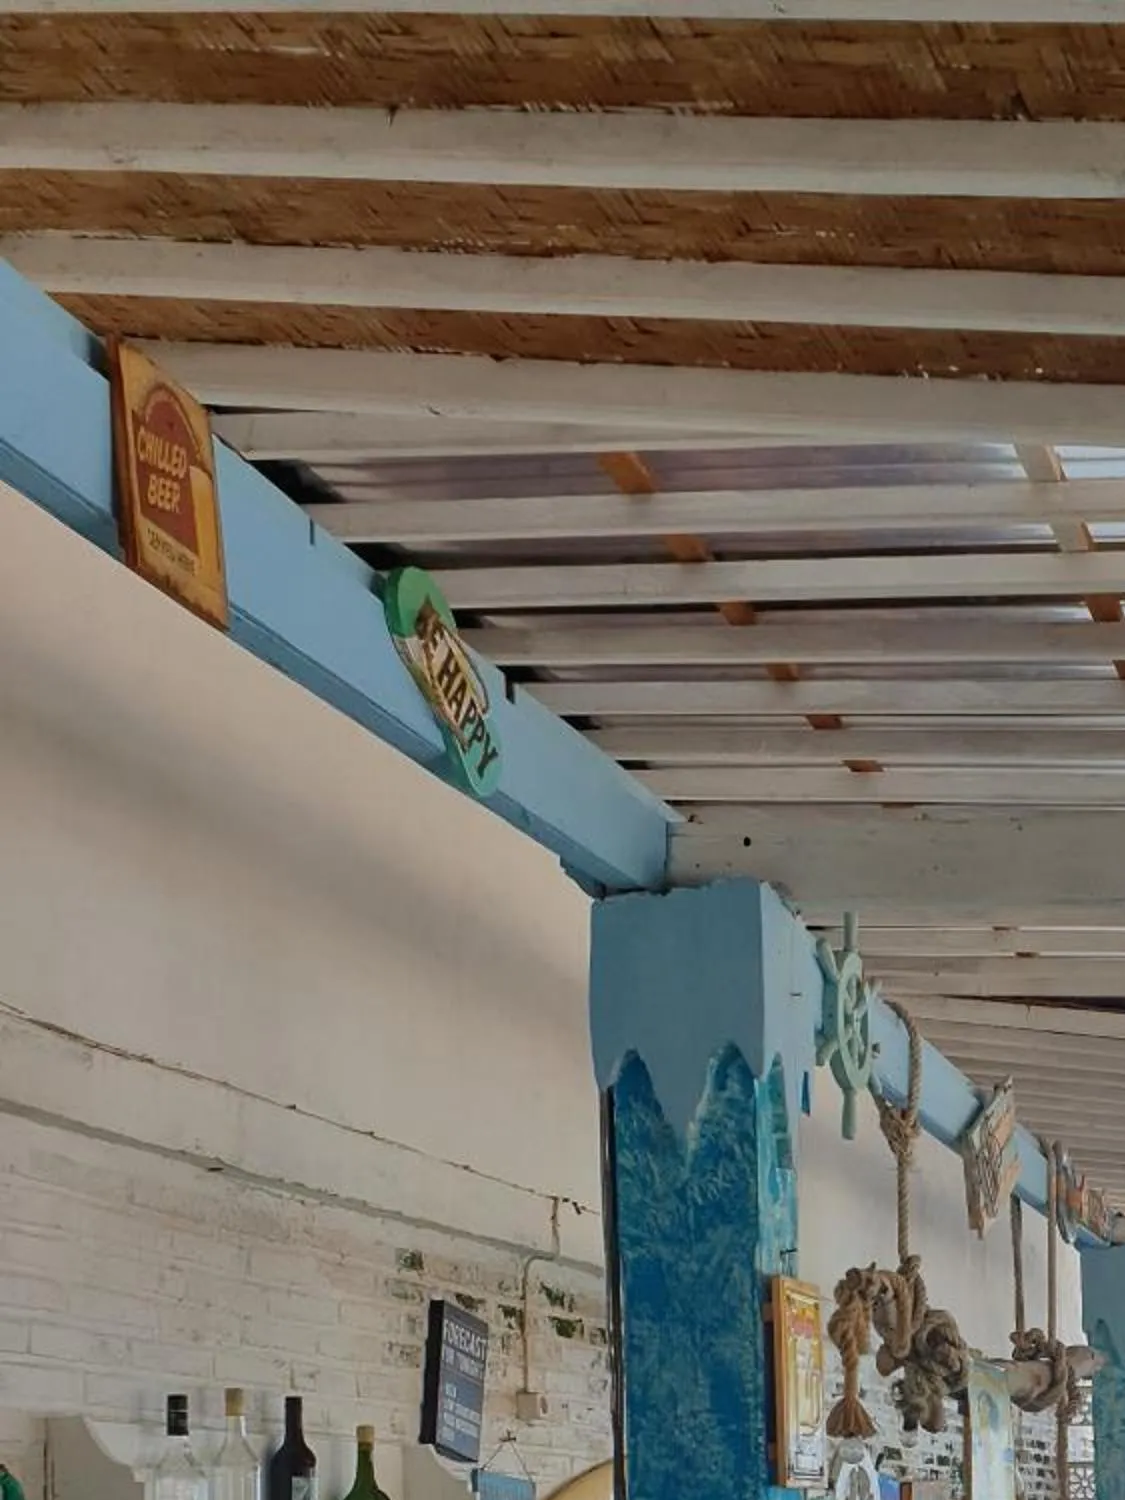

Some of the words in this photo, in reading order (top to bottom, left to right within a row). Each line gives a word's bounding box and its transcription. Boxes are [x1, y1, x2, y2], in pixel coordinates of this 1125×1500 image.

[137, 425, 188, 479] CHILLED
[147, 473, 181, 513] BEER
[436, 646, 499, 781] HAPPY
[442, 1318, 487, 1361] FORECAST
